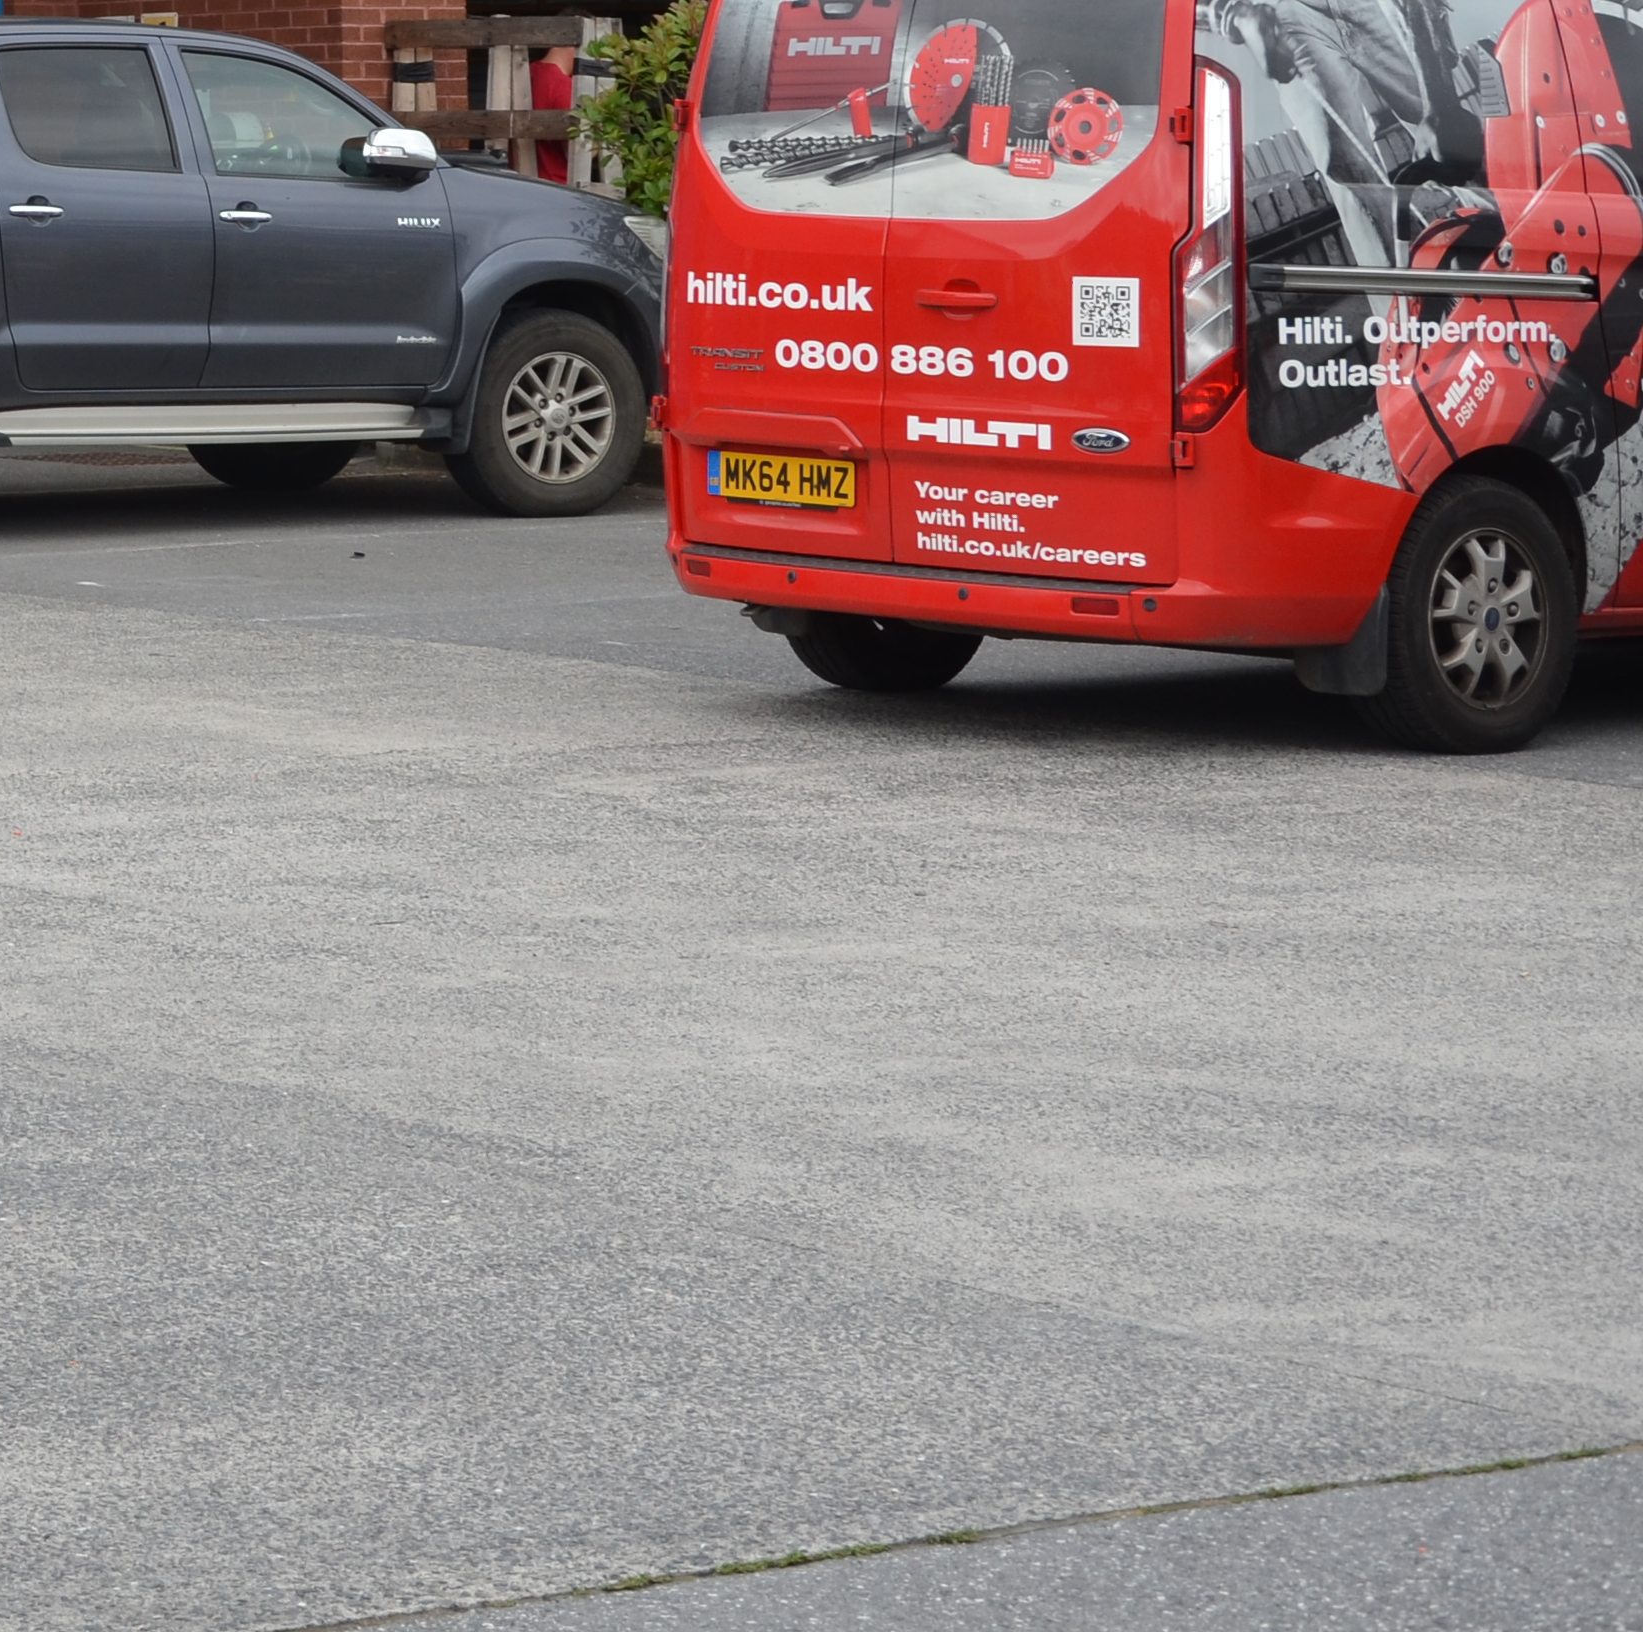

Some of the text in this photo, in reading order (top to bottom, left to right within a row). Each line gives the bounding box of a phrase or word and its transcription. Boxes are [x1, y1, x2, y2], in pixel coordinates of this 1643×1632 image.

[787, 36, 882, 57] HILTI
[396, 217, 440, 228] HILUX
[687, 270, 873, 312] hilti.co.uk
[1277, 314, 1557, 350] Hilti. Outperform.
[690, 346, 764, 359] TRANSIT
[714, 362, 765, 372] CUSTOM
[775, 338, 1069, 382] 0800 886 100
[1278, 358, 1412, 388] Outlast.
[1436, 348, 1485, 421] HILTI
[1454, 369, 1496, 429] DSH 900
[906, 415, 1052, 451] HILTI
[1081, 431, 1115, 449] Ford
[725, 457, 849, 500] MK64 HMZ
[914, 480, 1059, 509] Your career
[915, 507, 1026, 533] with Hilti.
[916, 531, 1148, 568] hilti.co.uk/careers
